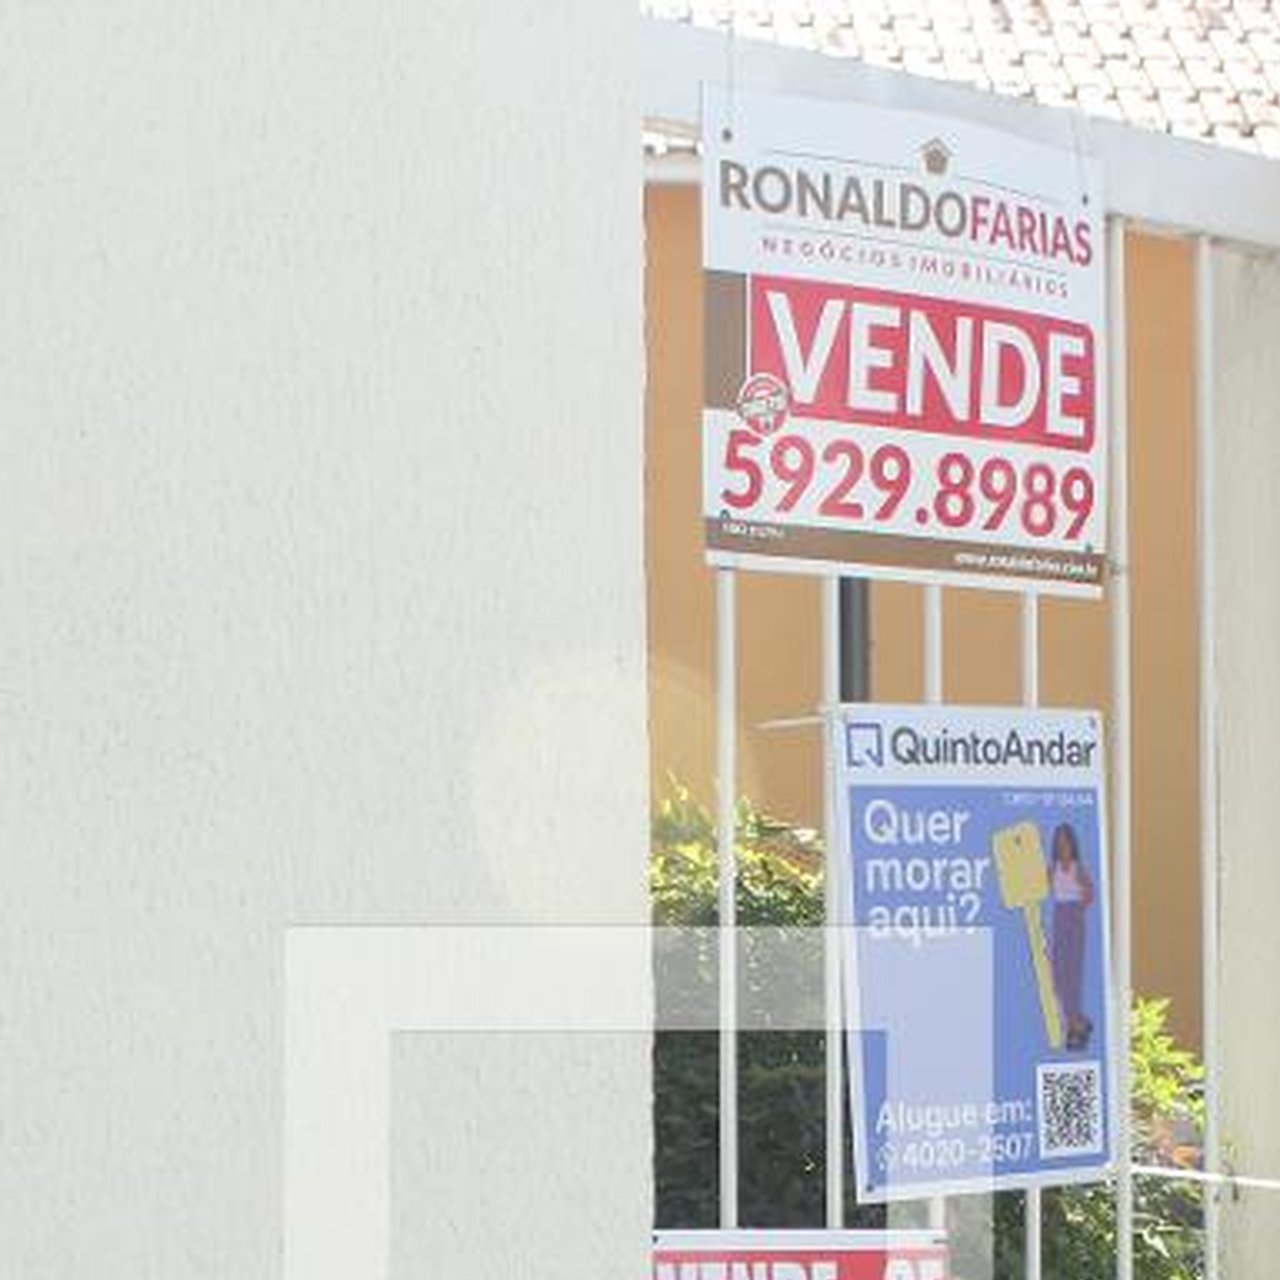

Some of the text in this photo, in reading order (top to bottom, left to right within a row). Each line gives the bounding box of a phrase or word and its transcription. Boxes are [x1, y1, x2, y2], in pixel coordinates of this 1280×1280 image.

[718, 159, 1094, 267] RONALDOFARIAS
[765, 290, 1086, 436] VENDE
[720, 429, 1095, 540] 5929.8989
[890, 727, 1096, 767] QuintoAndar
[864, 798, 969, 845] Quer
[865, 857, 990, 891] morar
[868, 892, 982, 947] aqui?
[875, 1099, 978, 1138] Alugue
